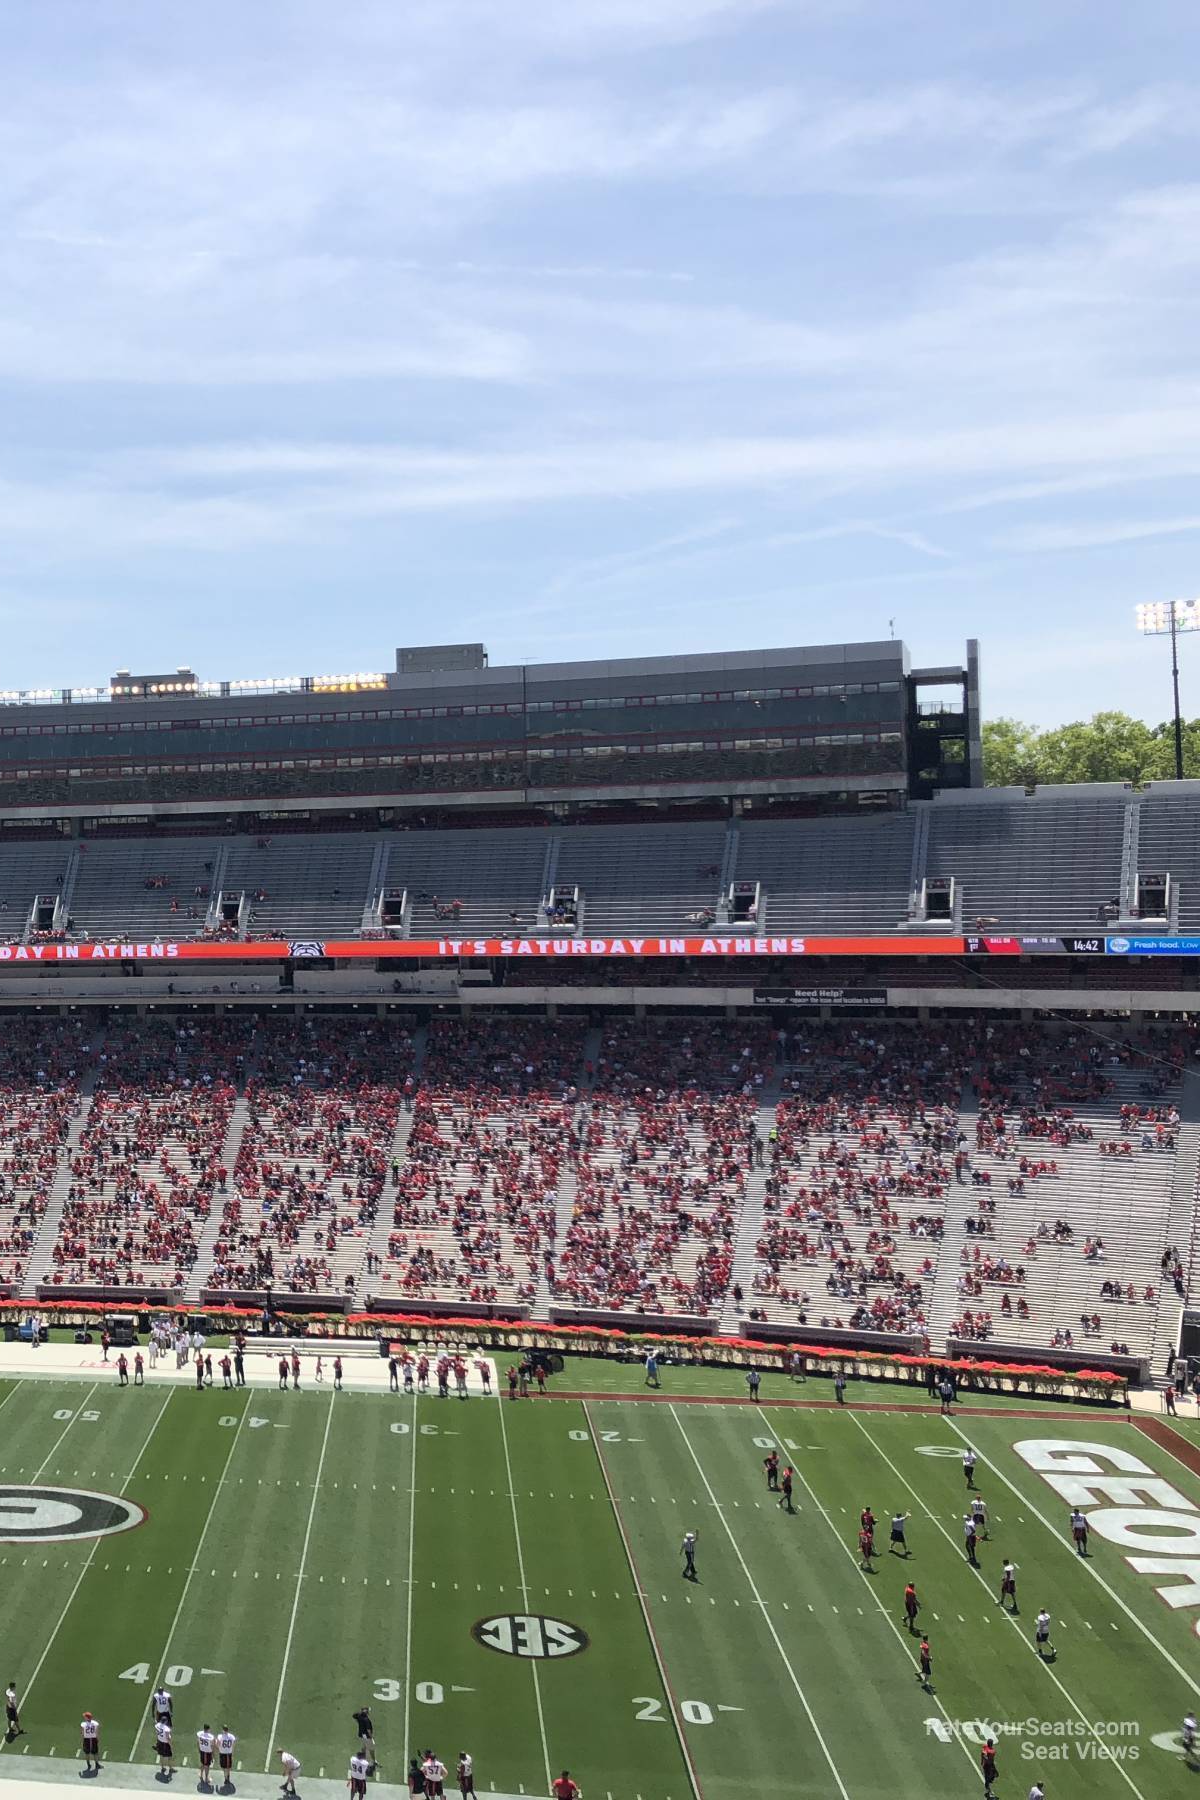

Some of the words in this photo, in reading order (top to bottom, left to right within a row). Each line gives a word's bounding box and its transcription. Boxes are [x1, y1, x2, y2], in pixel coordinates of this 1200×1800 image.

[438, 941, 487, 955] IT'S
[500, 940, 646, 954] SATURDAY
[658, 939, 686, 953] IN
[699, 938, 806, 953] ATHENS
[1074, 940, 1099, 951] 14:42
[1159, 941, 1180, 949] food.
[57, 945, 79, 959] IN
[92, 944, 179, 958] ATHENS
[795, 989, 817, 997] Need
[820, 989, 844, 998] Help?
[53, 1409, 101, 1421] 50
[218, 1416, 269, 1428] 40
[390, 1423, 439, 1435] 30
[568, 1430, 622, 1442] 20
[752, 1437, 802, 1450] 10
[1012, 1439, 1200, 1627] GEOR
[480, 1616, 582, 1657] SEC
[118, 1662, 194, 1687] 40
[373, 1678, 445, 1704] 30
[631, 1696, 715, 1725] 20
[923, 1717, 999, 1745] 10
[222, 1739, 232, 1749] 60
[427, 1766, 439, 1775] 57
